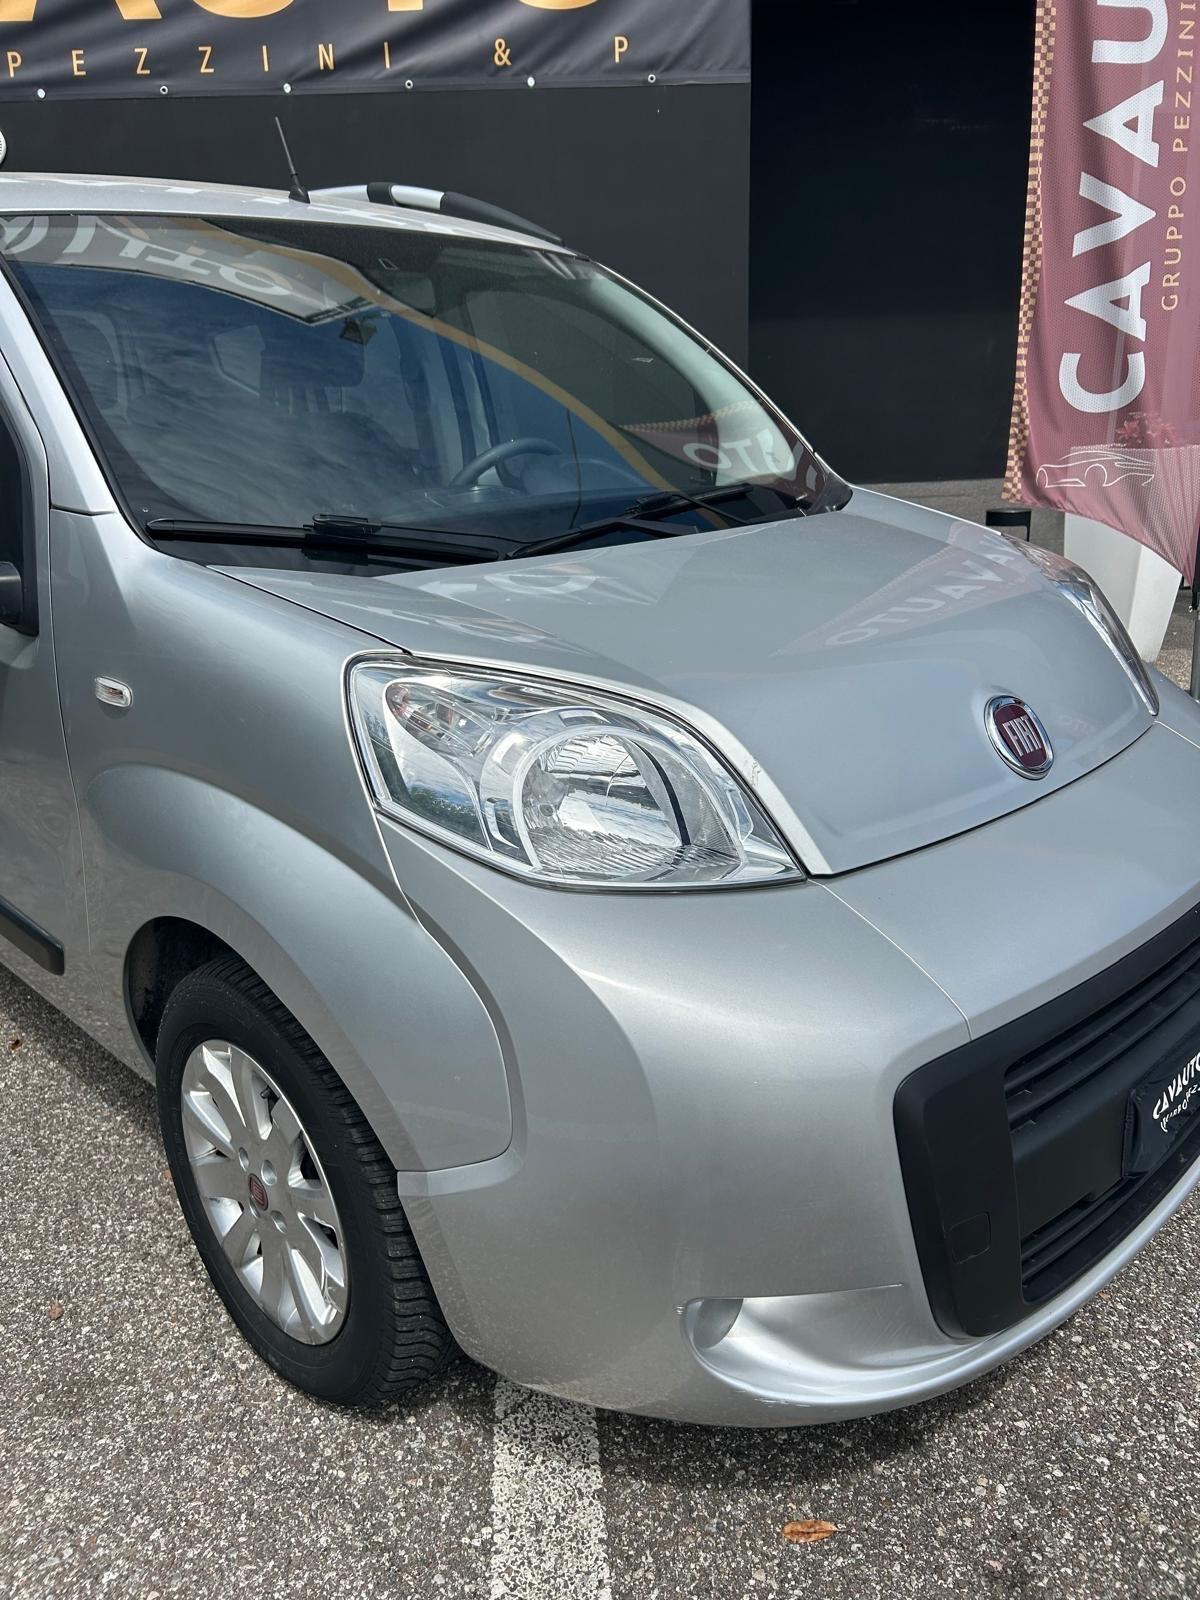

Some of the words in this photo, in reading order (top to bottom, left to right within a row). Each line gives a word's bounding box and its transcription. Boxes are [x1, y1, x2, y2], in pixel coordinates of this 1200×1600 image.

[6, 41, 392, 78] PEZZINI
[493, 38, 512, 66] &
[1172, 1, 1196, 152] PEZZINI
[1161, 176, 1187, 311] GRUPPO
[1002, 714, 1043, 757] FIAT
